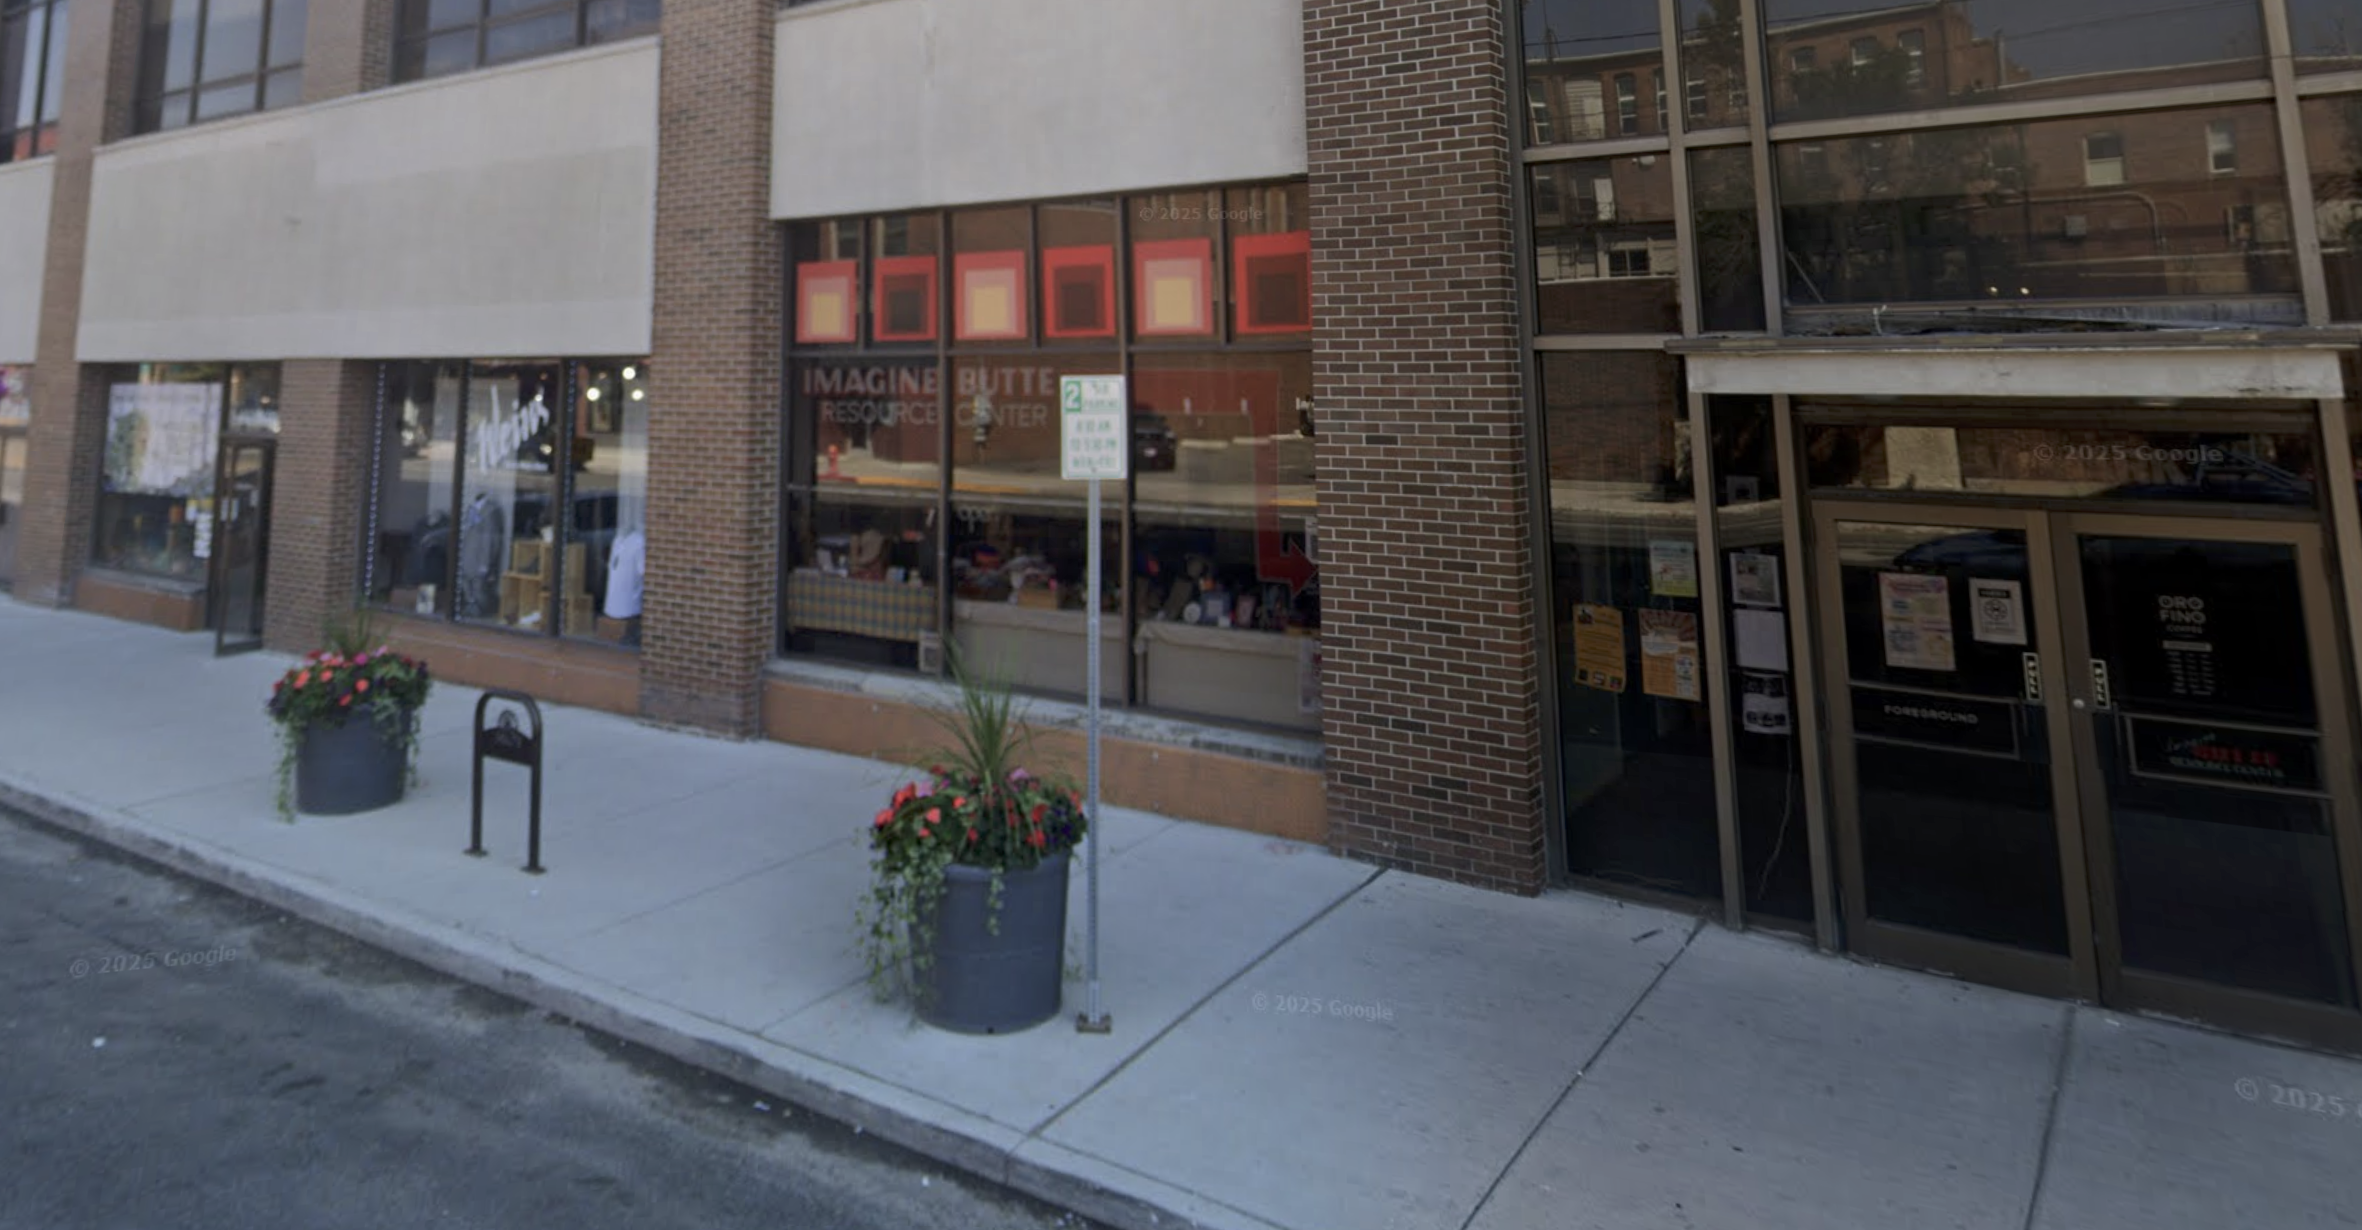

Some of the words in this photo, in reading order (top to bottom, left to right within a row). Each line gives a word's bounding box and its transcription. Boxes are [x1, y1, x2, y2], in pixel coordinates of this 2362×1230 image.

[803, 366, 938, 396] IMAGINE
[957, 366, 1056, 396] BUTTE
[1065, 382, 1080, 410] 2
[820, 399, 938, 426] RESOURCE
[954, 401, 1049, 427] CNTER
[2158, 595, 2204, 610] ORO
[2159, 609, 2207, 624] FINO
[1883, 704, 1980, 725] FOREGROUND
